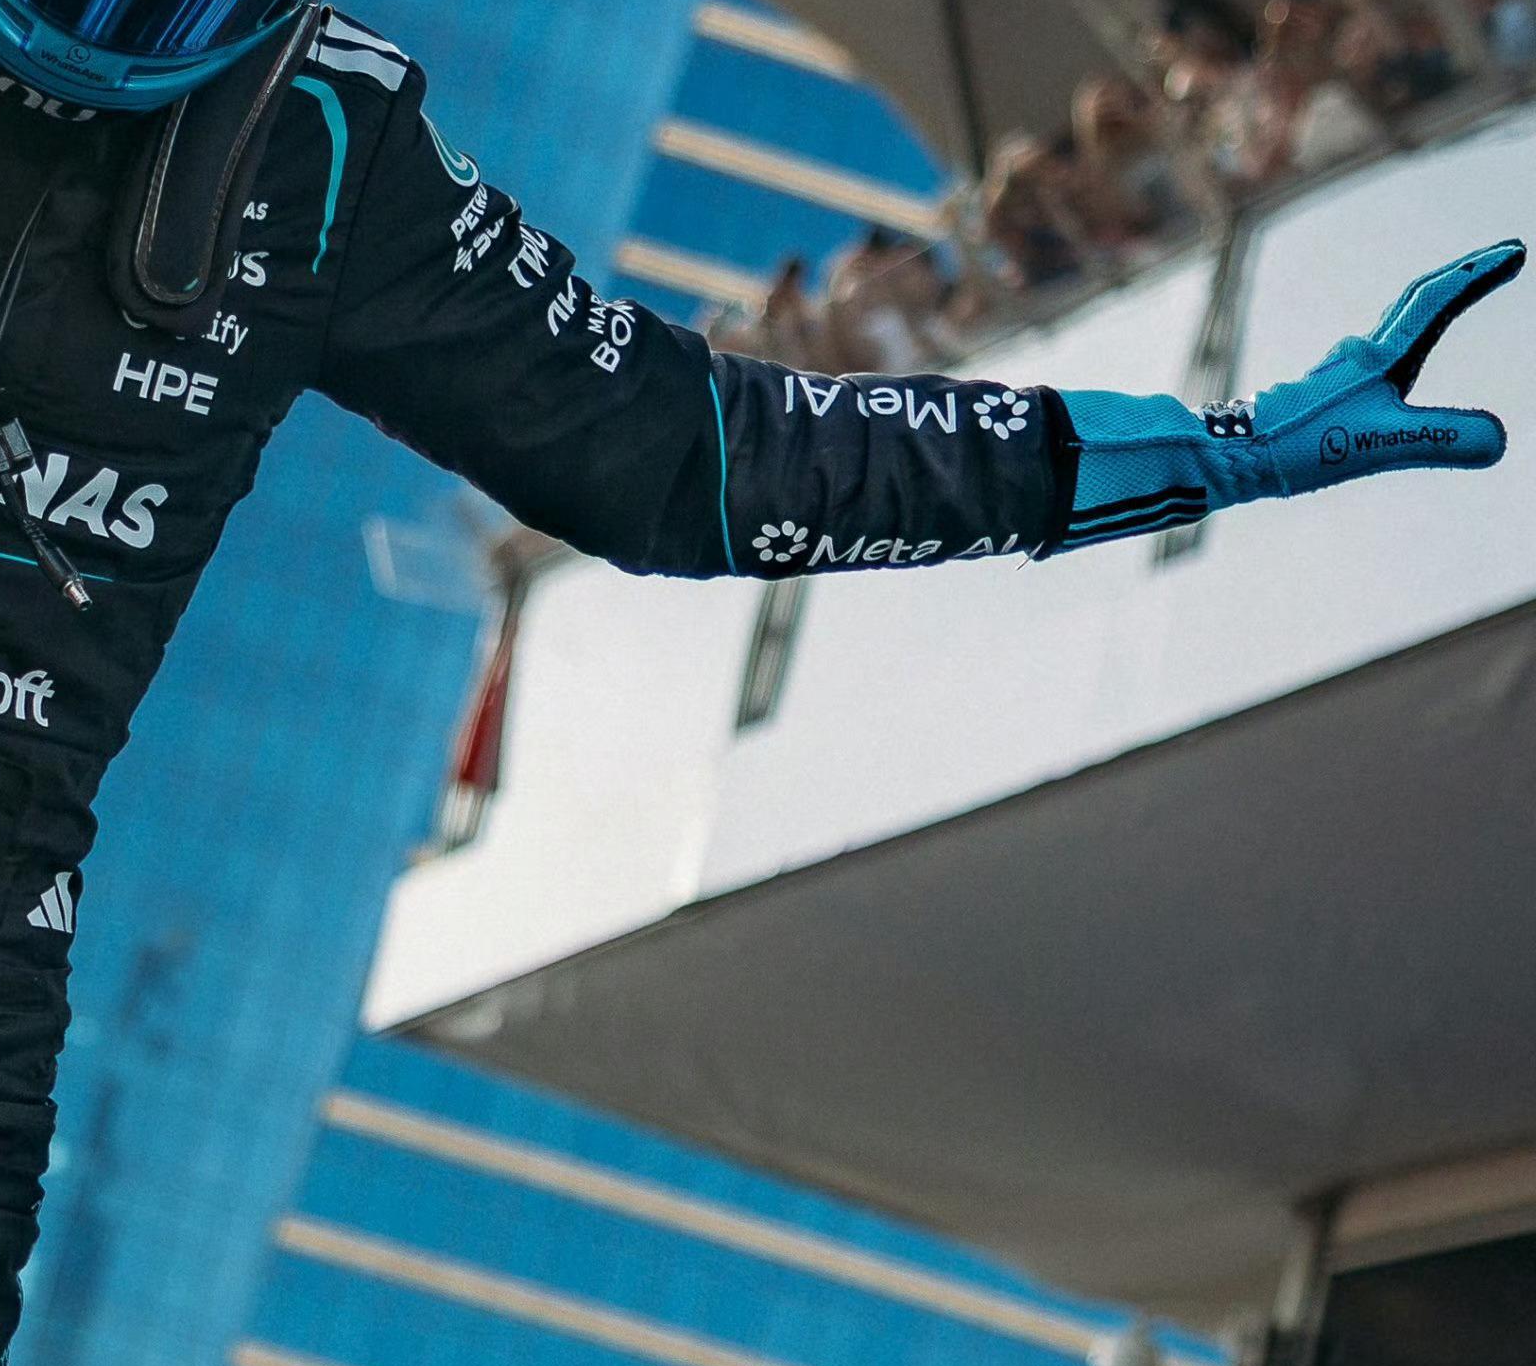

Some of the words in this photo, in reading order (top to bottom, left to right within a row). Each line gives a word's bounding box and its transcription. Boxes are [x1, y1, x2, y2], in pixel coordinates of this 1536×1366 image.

[112, 352, 219, 416] HPE
[1353, 426, 1459, 454] WhatsApp
[807, 534, 943, 567] Meta
